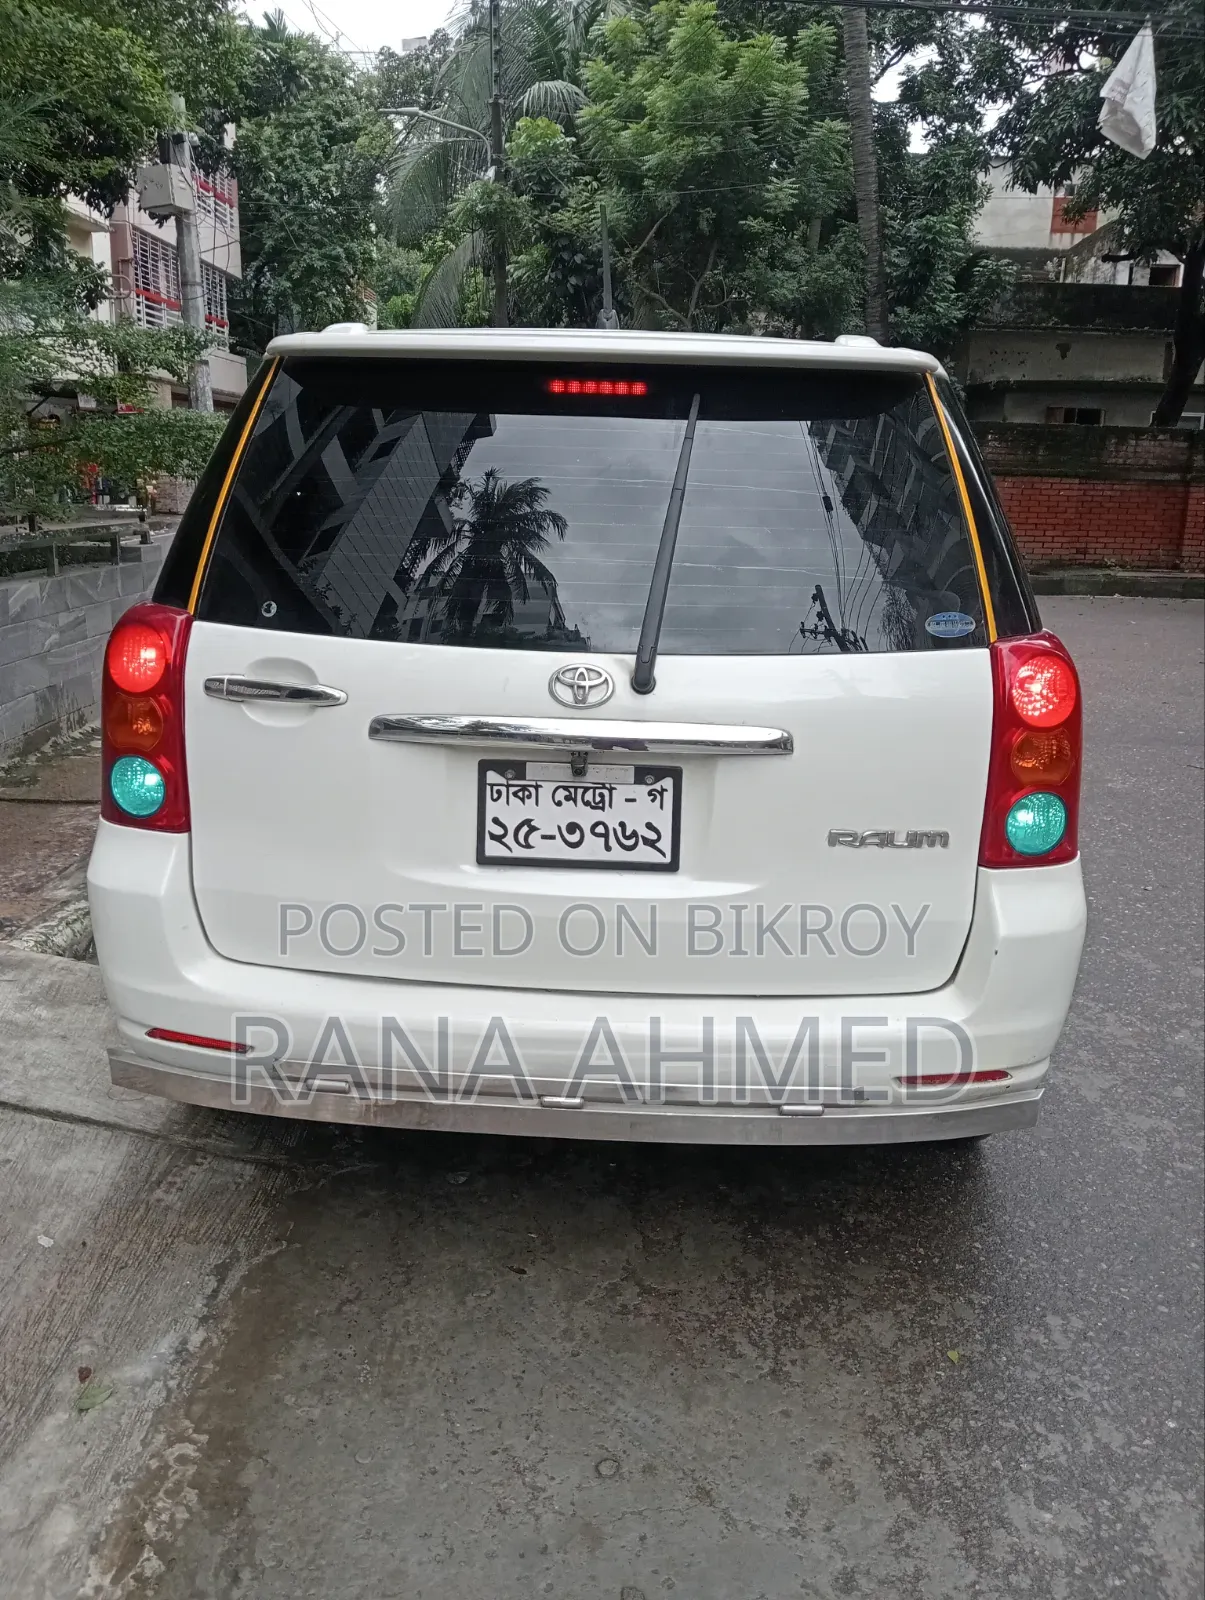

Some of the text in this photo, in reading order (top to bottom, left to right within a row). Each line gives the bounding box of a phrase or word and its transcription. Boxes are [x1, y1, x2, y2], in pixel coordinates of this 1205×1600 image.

[487, 779, 543, 807] ঢাকা
[551, 782, 617, 812] মেট্রো
[647, 784, 668, 811] গ
[487, 816, 667, 859] ২৫-৩৭৬২
[827, 828, 950, 848] RAUM
